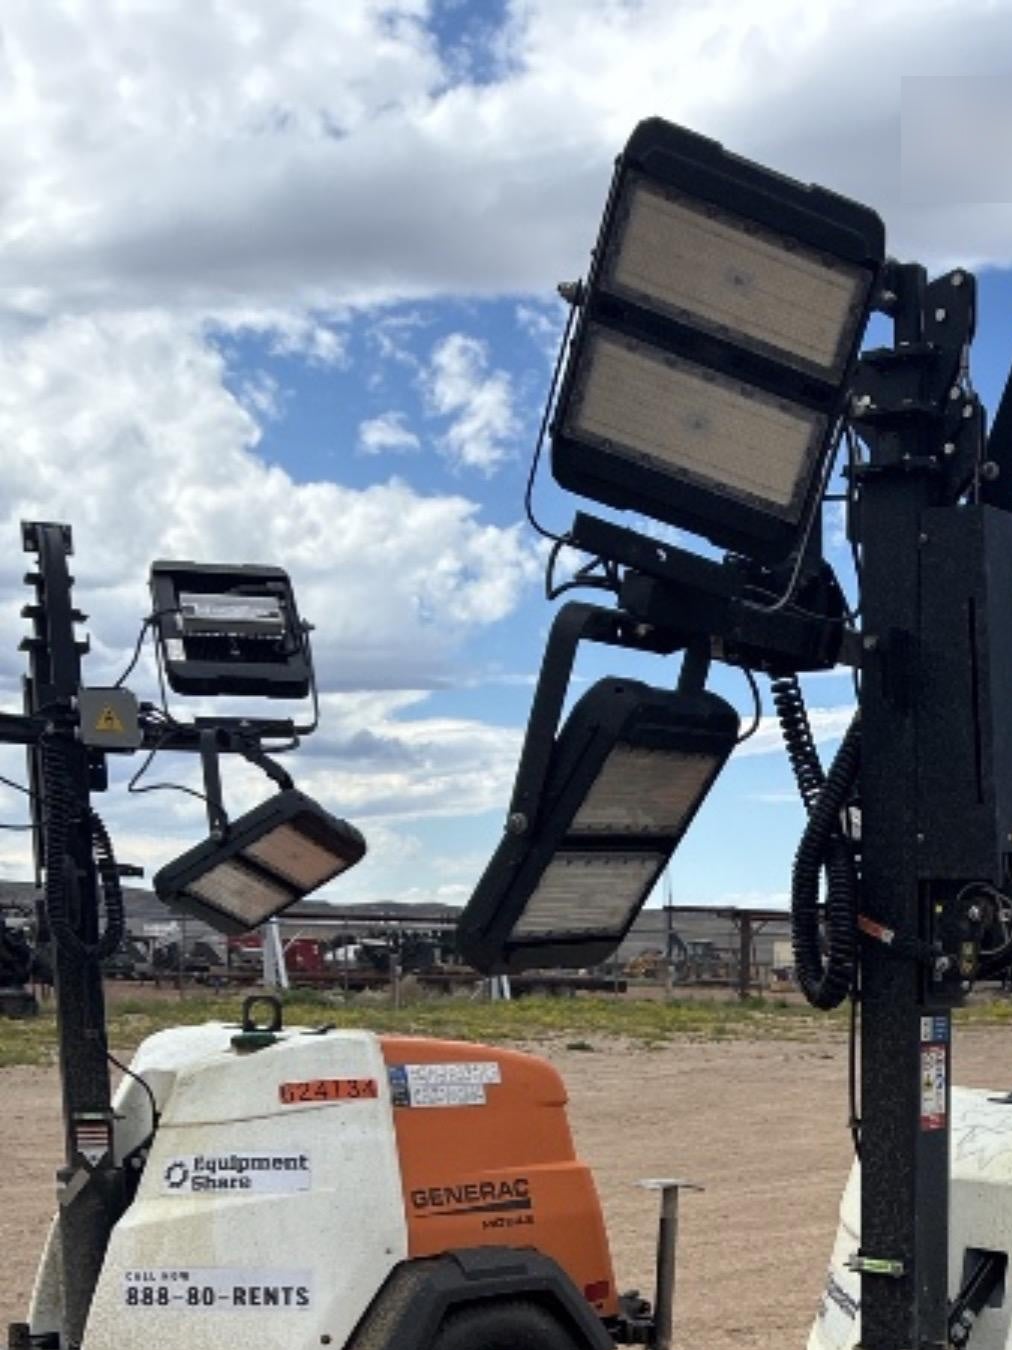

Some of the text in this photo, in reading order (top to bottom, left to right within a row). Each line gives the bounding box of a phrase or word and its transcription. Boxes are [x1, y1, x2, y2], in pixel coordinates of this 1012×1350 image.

[194, 1154, 309, 1174] Equipment
[191, 1175, 252, 1191] Share
[411, 1178, 529, 1209] GENERAC
[125, 1271, 156, 1282] CALL
[126, 1286, 310, 1306] 888-80-RENTS
